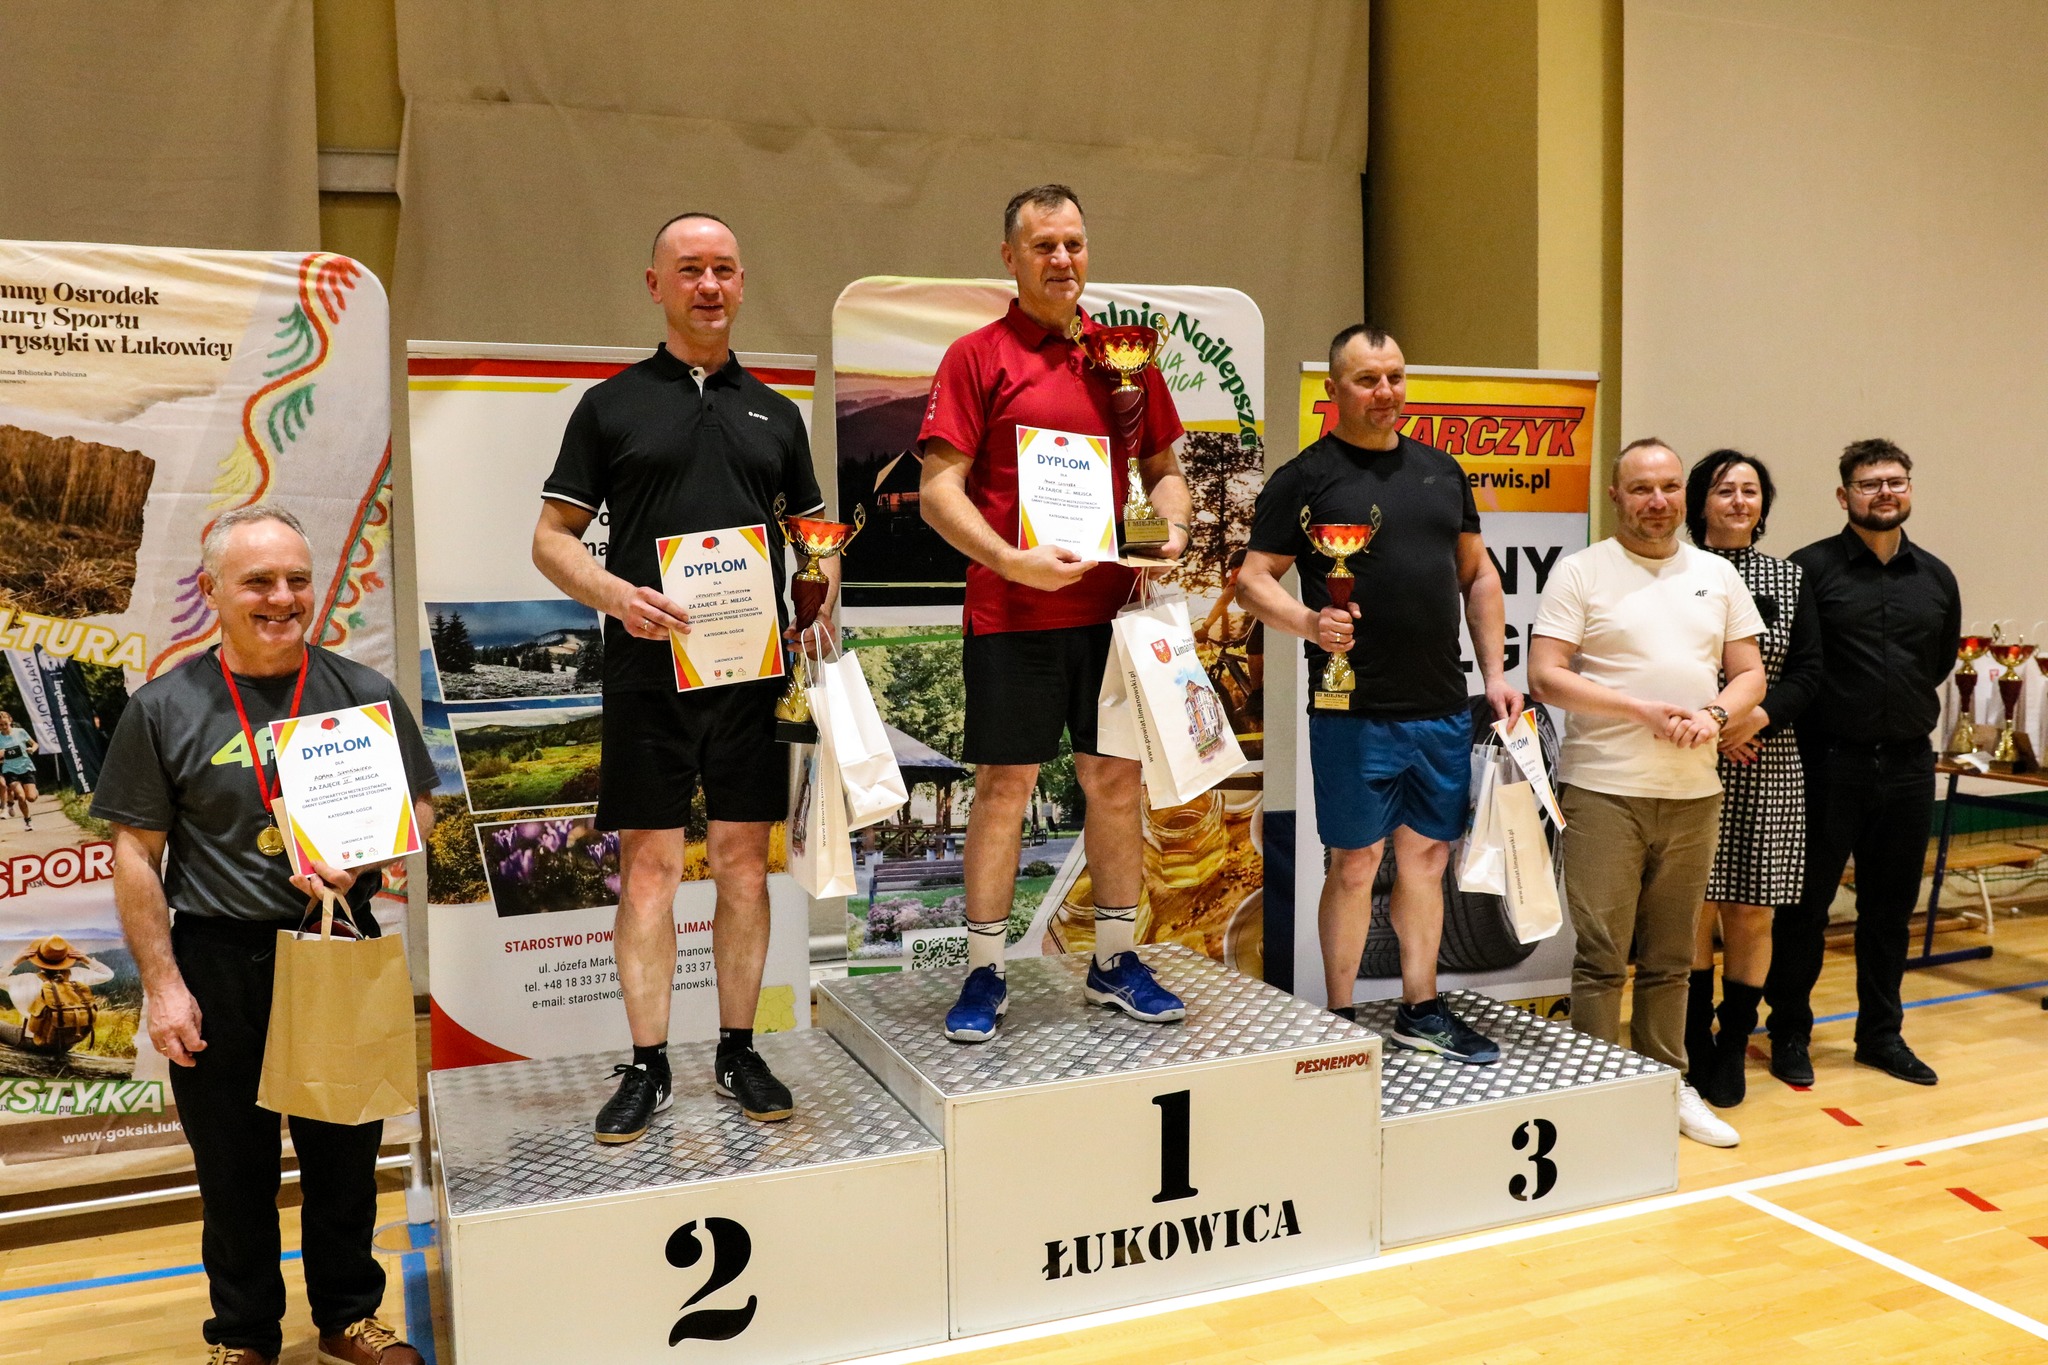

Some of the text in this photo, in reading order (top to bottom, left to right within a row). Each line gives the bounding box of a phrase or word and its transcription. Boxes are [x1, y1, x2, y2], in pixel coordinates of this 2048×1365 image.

[54, 282, 160, 305] Ośrodek
[0, 306, 140, 331] ury Sportu
[94, 338, 117, 353] w
[121, 335, 233, 362] Łukowicy
[1170, 311, 1257, 447] Najlepsza
[1037, 454, 1090, 471] DYPLOM
[684, 558, 747, 578] DYPLOM
[698, 601, 718, 609] ZAJĘCIE
[730, 596, 752, 604] MIEJSCA
[1128, 670, 1154, 763] www.powiat.limanowski.pl
[302, 736, 371, 760] DYPLOM
[319, 781, 341, 790] ZAJĘCIE
[355, 773, 379, 782] MIEJSCA
[505, 934, 583, 953] STAROSTWO
[524, 982, 540, 992] tel.
[544, 979, 562, 990] +48
[566, 978, 577, 988] 18
[580, 976, 592, 986] 33
[595, 974, 607, 984] 37
[686, 963, 697, 973] 33
[700, 962, 711, 972] 37
[539, 963, 551, 974] ul.
[554, 959, 587, 972] Józefa
[532, 996, 566, 1009] e-mail:
[62, 1120, 183, 1144] www.goksit.luk
[1152, 1090, 1199, 1204] 1
[1508, 1118, 1558, 1202] 3
[1042, 1200, 1302, 1281] ŁUKOWICA
[665, 1217, 758, 1348] 2
